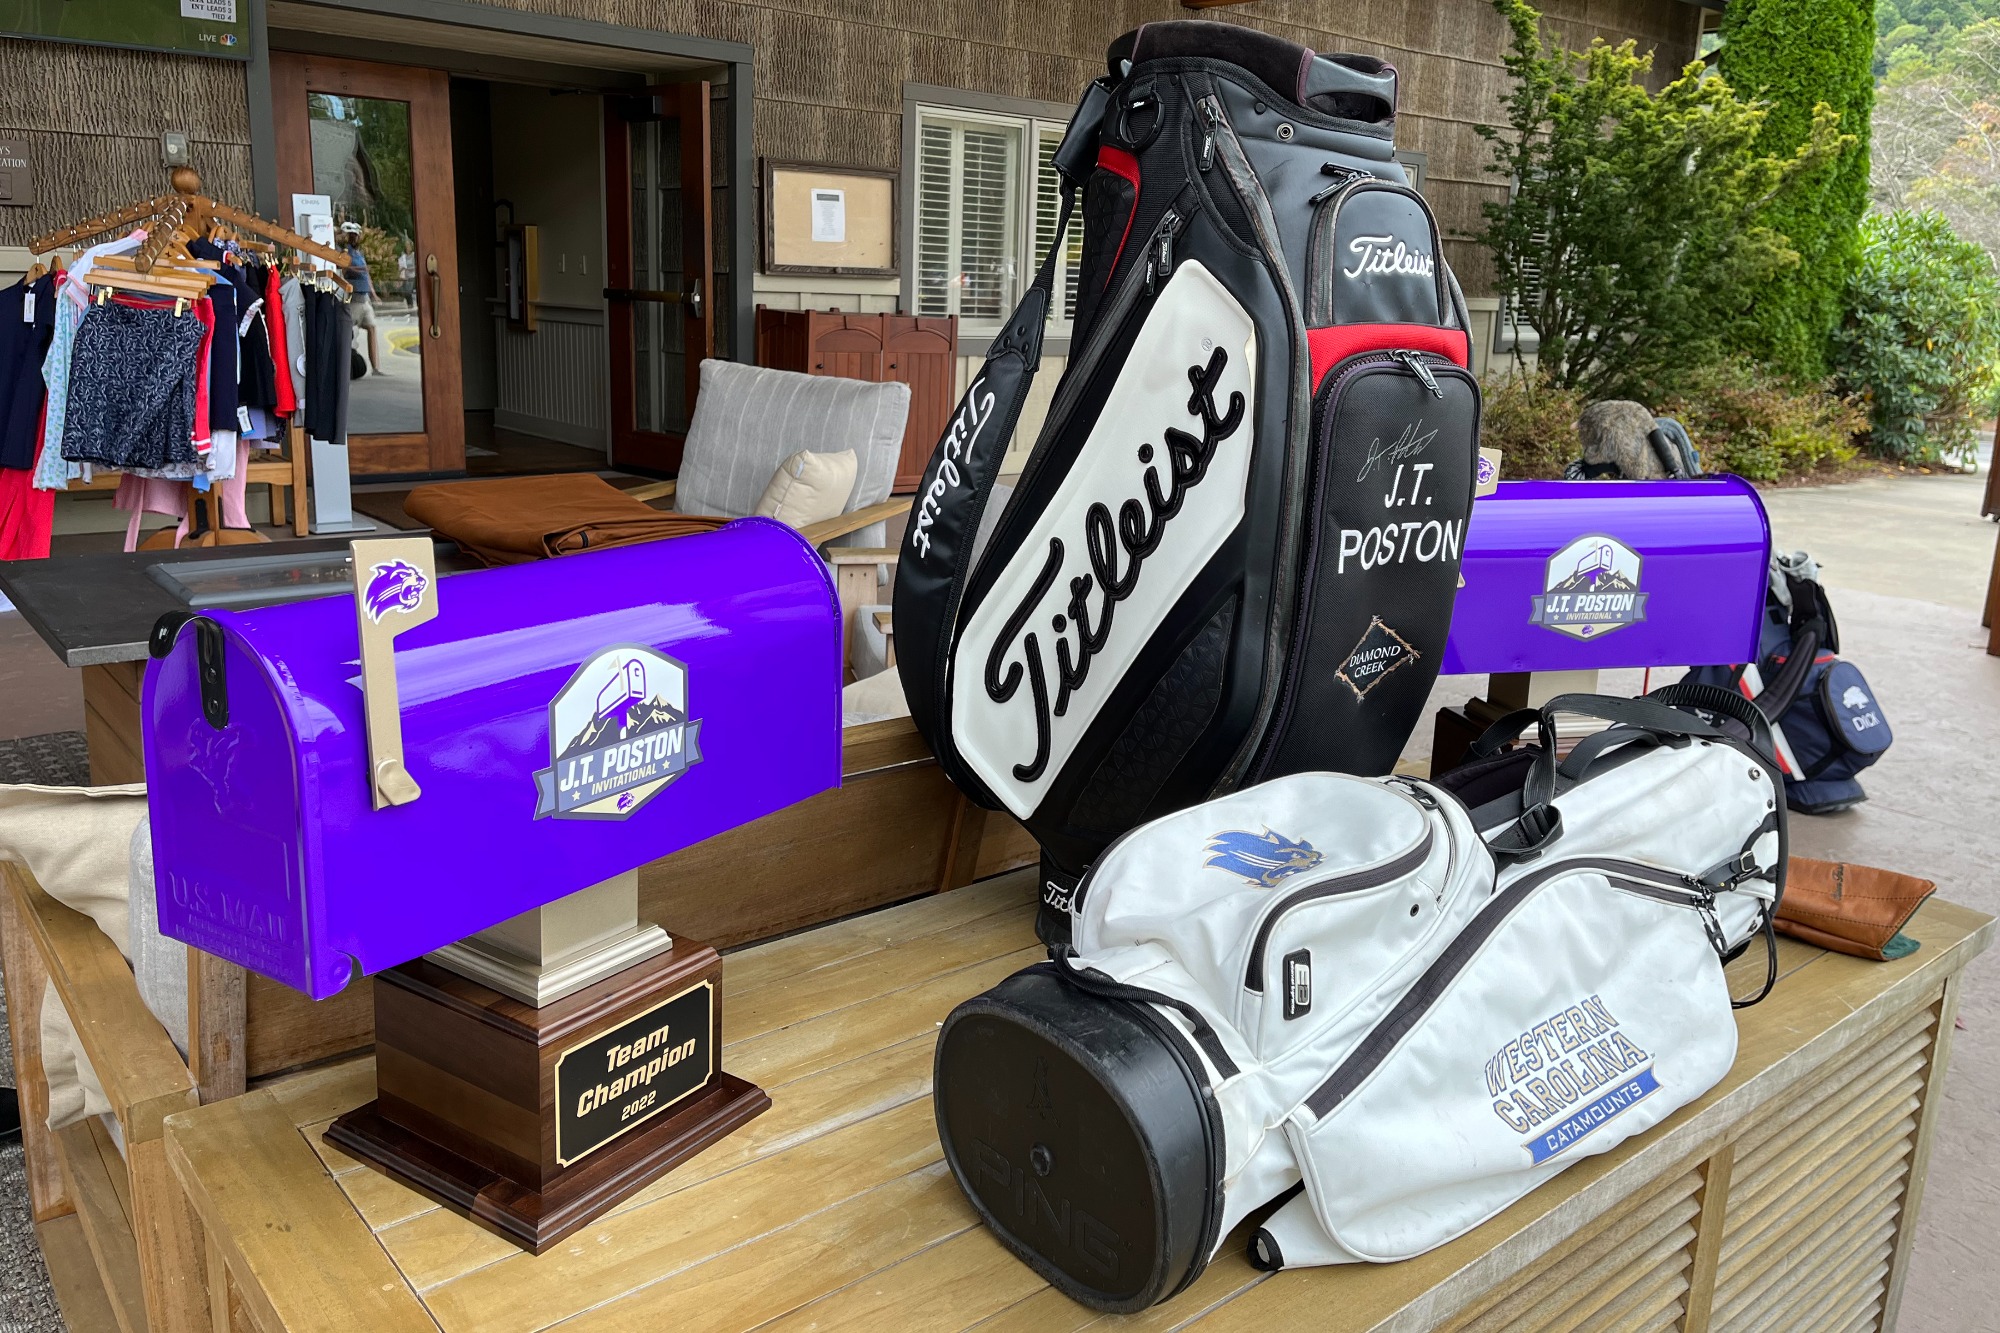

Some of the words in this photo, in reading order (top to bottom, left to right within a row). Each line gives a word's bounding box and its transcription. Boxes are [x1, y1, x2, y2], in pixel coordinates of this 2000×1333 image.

[207, 5, 226, 13] LEADS
[199, 34, 217, 42] LIVE
[1344, 234, 1434, 278] Titleist
[913, 376, 995, 559] Titleist
[1384, 463, 1434, 508] J.T.
[984, 345, 1245, 782] Titleist
[1338, 518, 1463, 574] POSTON
[1546, 595, 1569, 613] J.T.
[1574, 593, 1635, 613] POSTON
[1566, 612, 1612, 621] INVITATIONAL
[1349, 645, 1401, 667] DIAMOND
[1354, 660, 1387, 679] CREEK
[1852, 711, 1880, 732] DICK
[560, 754, 594, 792] J.T.
[601, 725, 684, 778] POSTON
[591, 763, 657, 796] INVITATIONAL
[607, 1024, 670, 1073] Team
[1485, 994, 1620, 1097] WESTERN
[576, 1038, 696, 1118] Champion
[1492, 1031, 1649, 1135] CAROLINA
[620, 1090, 657, 1122] 2022
[1546, 1081, 1643, 1151] CATAMOUNTS
